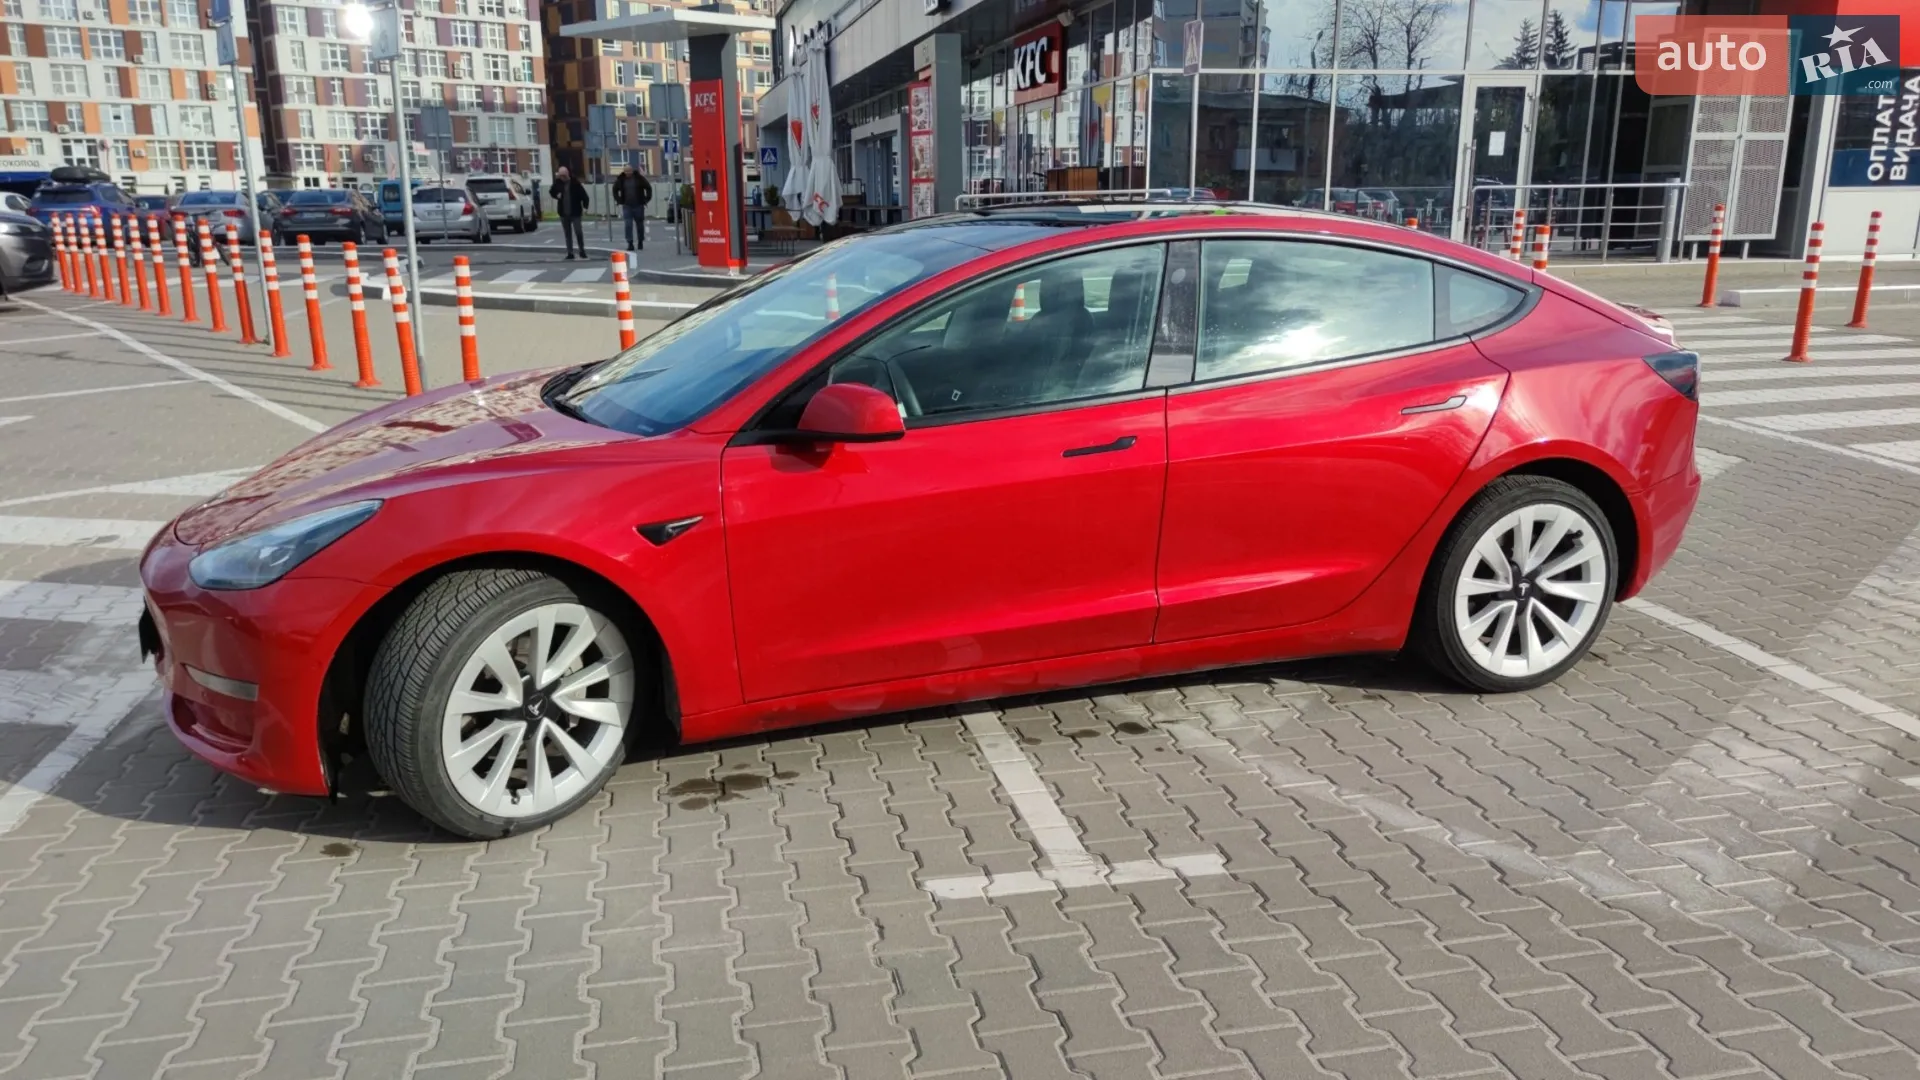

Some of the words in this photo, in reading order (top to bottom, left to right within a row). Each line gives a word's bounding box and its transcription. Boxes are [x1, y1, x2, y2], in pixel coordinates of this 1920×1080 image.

[1013, 36, 1048, 90] KFC
[695, 92, 717, 107] KFC
[1890, 75, 1920, 180] ВИДАЧА
